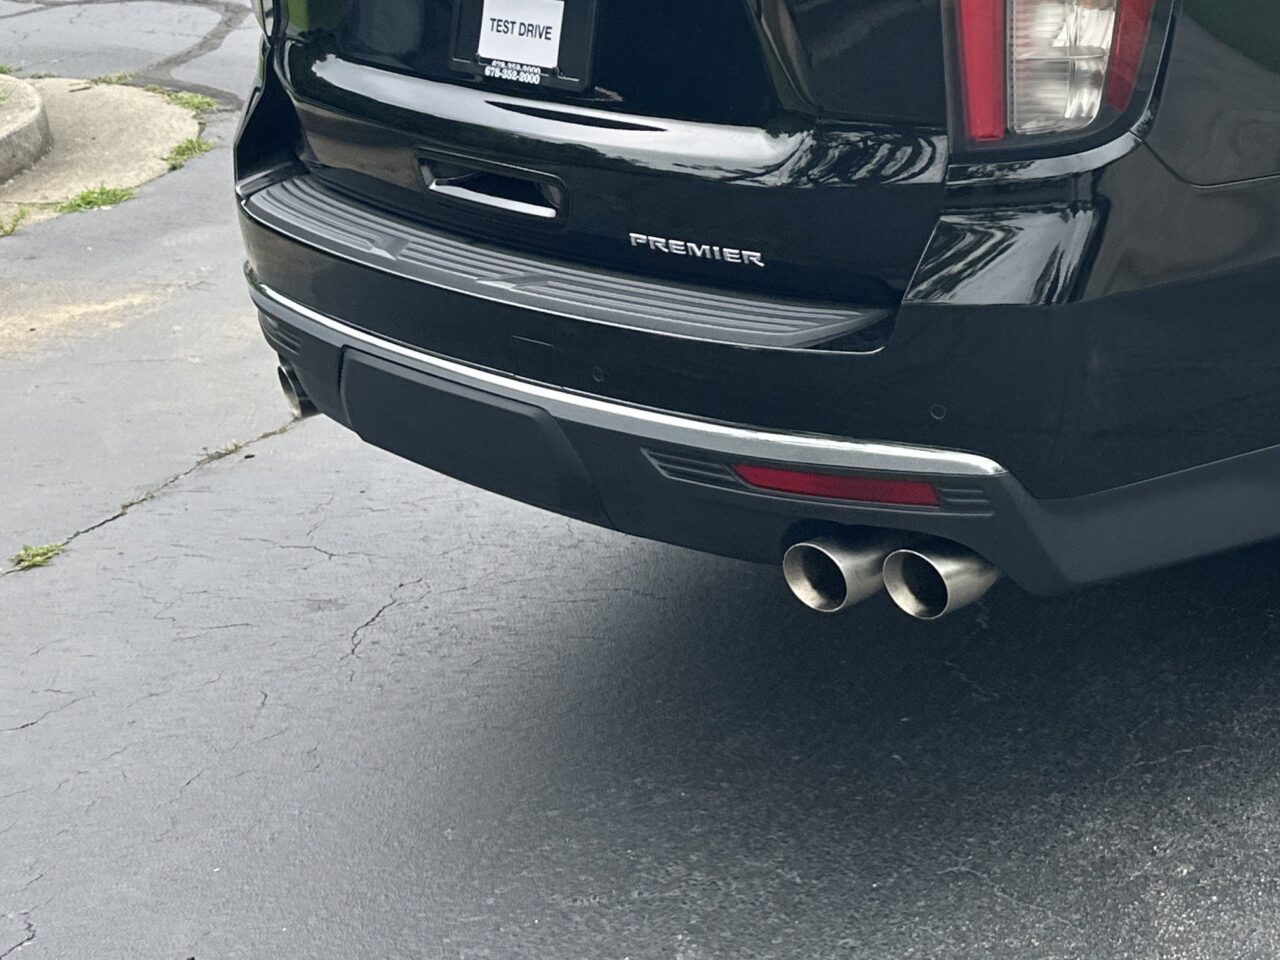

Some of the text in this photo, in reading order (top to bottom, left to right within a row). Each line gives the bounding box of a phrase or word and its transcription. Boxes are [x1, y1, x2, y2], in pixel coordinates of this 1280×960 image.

[489, 18, 553, 41] TEST DRIVE
[484, 66, 540, 85] 678-352-2000
[629, 232, 765, 267] PREMIER
